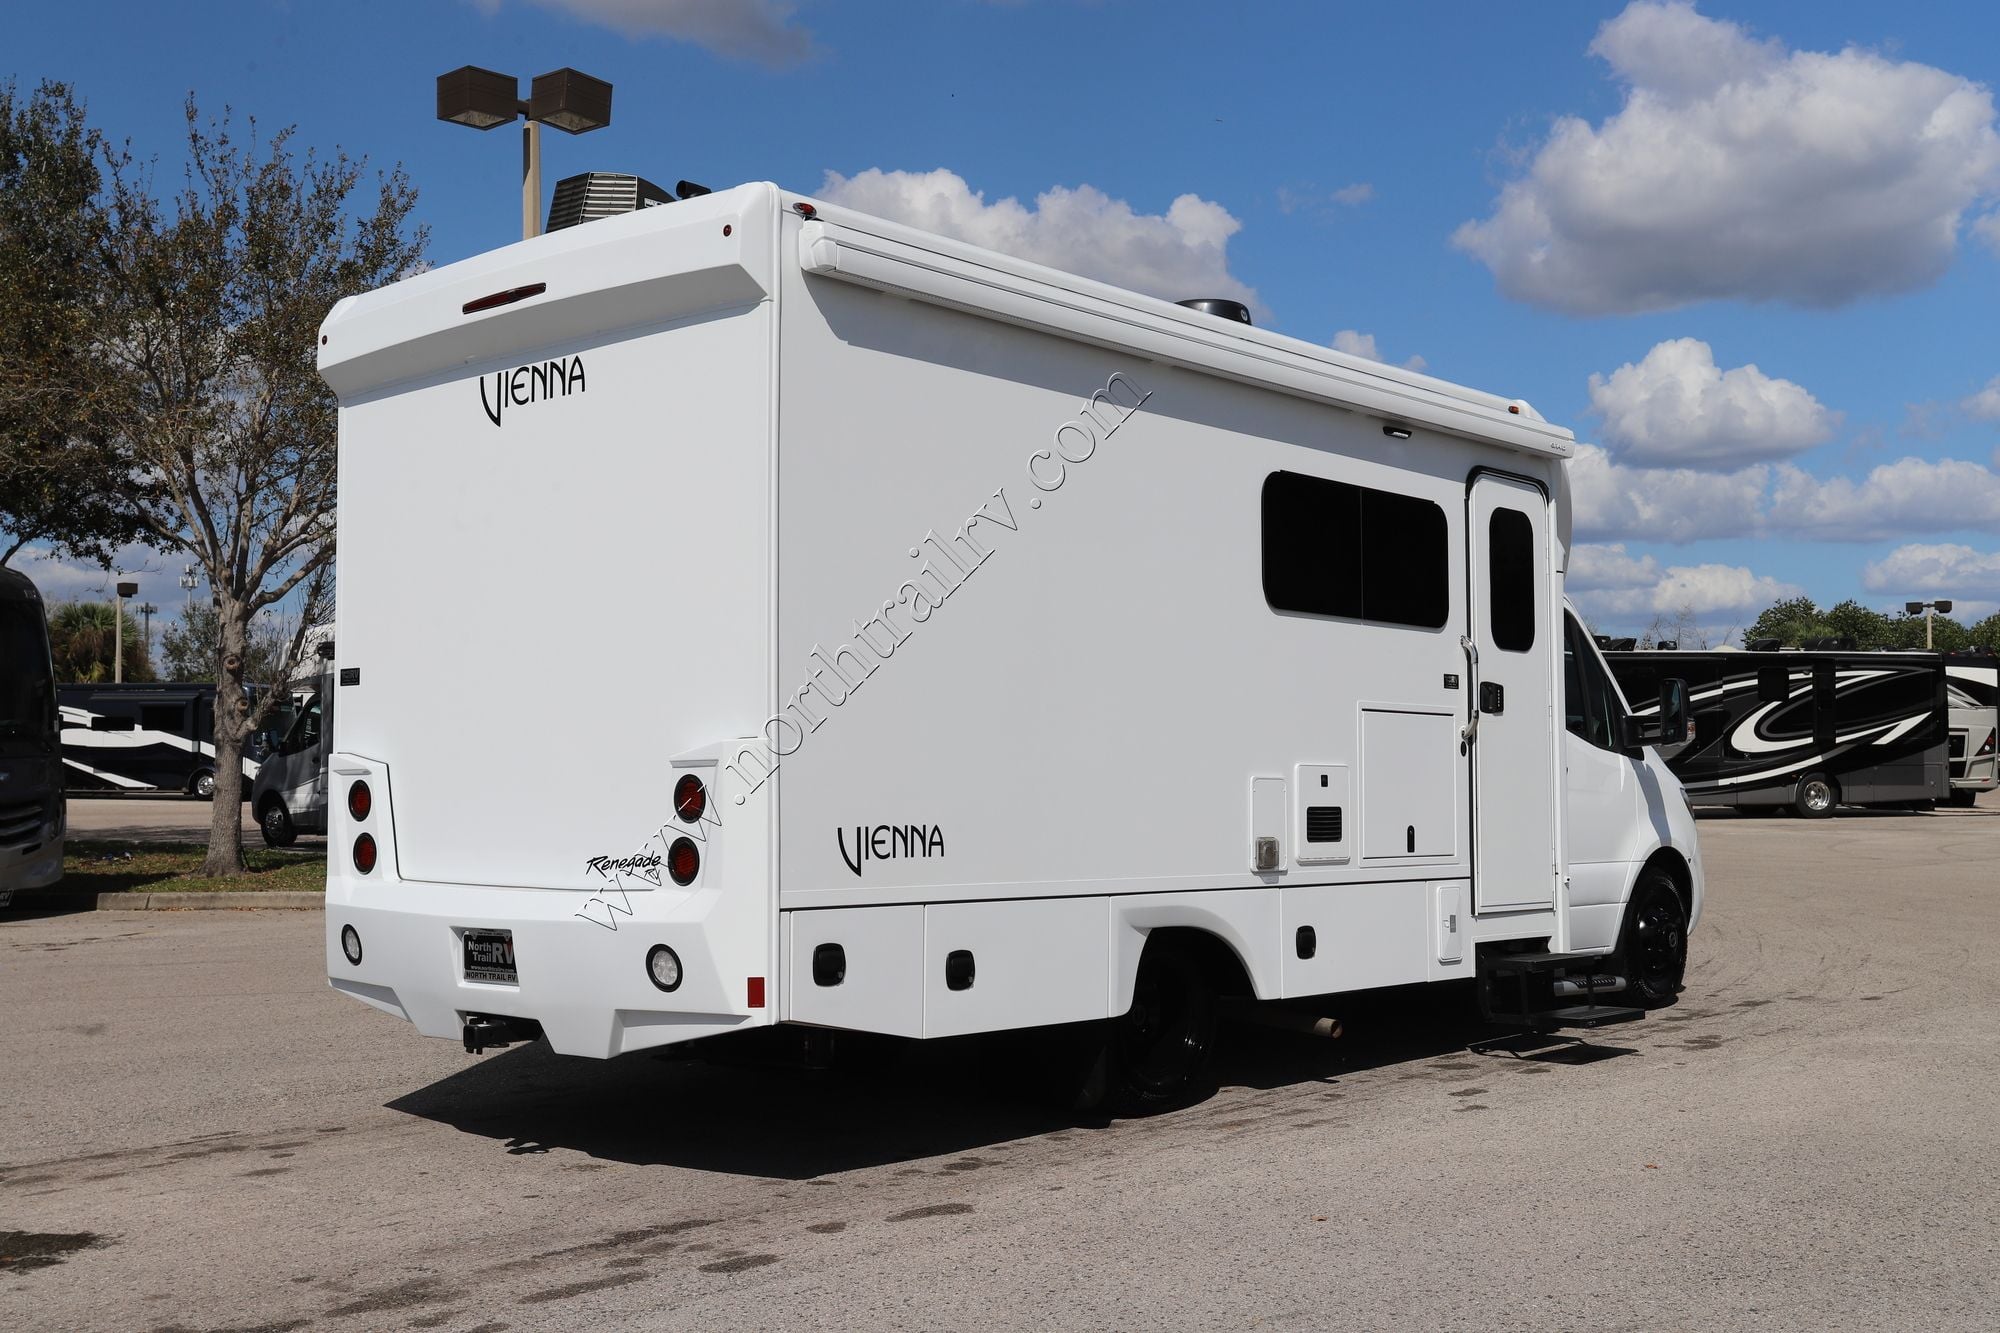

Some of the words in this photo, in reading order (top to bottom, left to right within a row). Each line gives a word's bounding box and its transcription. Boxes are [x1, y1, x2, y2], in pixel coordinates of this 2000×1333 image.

[480, 355, 585, 427] VIENNA
[837, 824, 944, 877] VIENNA
[586, 850, 661, 878] Renegade
[644, 868, 661, 880] RV
[468, 941, 491, 952] North
[492, 942, 514, 964] RV
[473, 952, 491, 962] Trail
[466, 971, 487, 980] NORTH
[488, 972, 506, 981] TRAIL
[507, 974, 516, 982] RV
